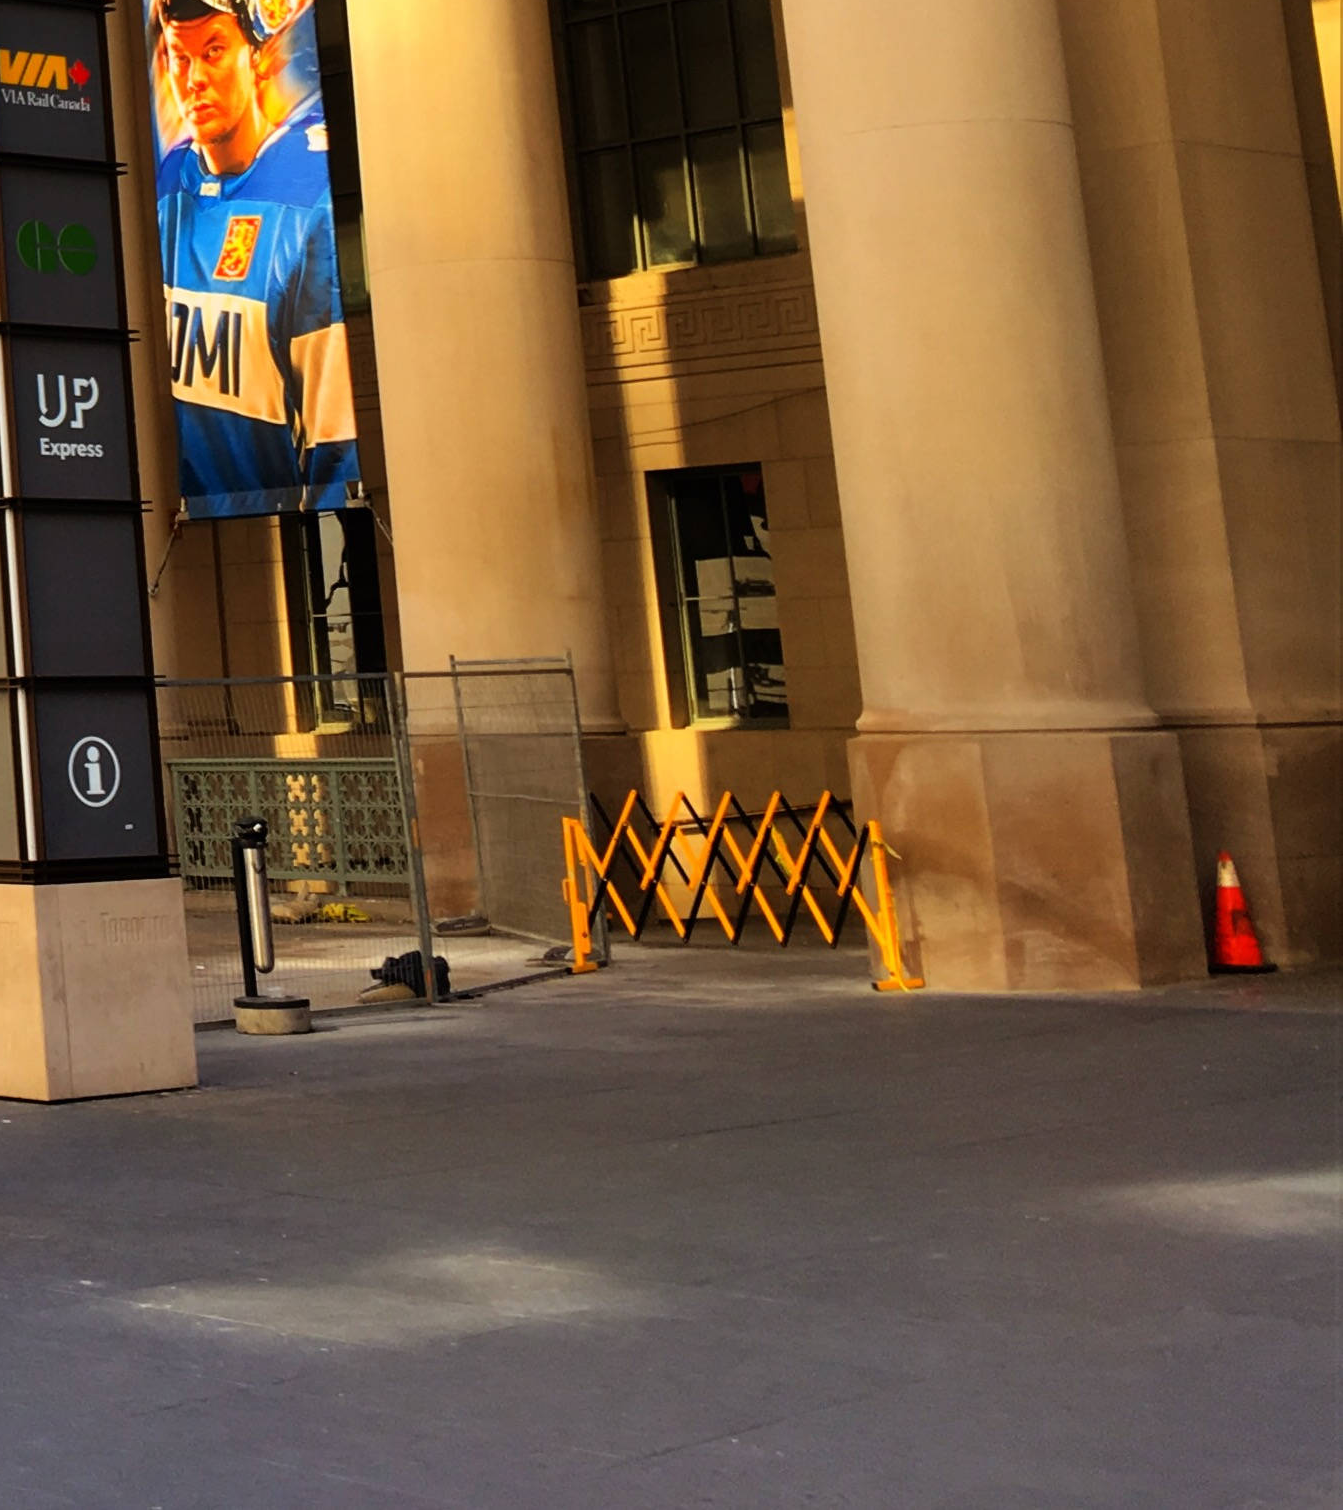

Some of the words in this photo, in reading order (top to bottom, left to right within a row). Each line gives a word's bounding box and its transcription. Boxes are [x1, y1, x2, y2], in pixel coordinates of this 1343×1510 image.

[1, 88, 26, 105] VIA
[27, 91, 49, 107] Rail
[50, 94, 91, 112] Canada
[37, 374, 99, 429] UP
[39, 437, 104, 460] Express
